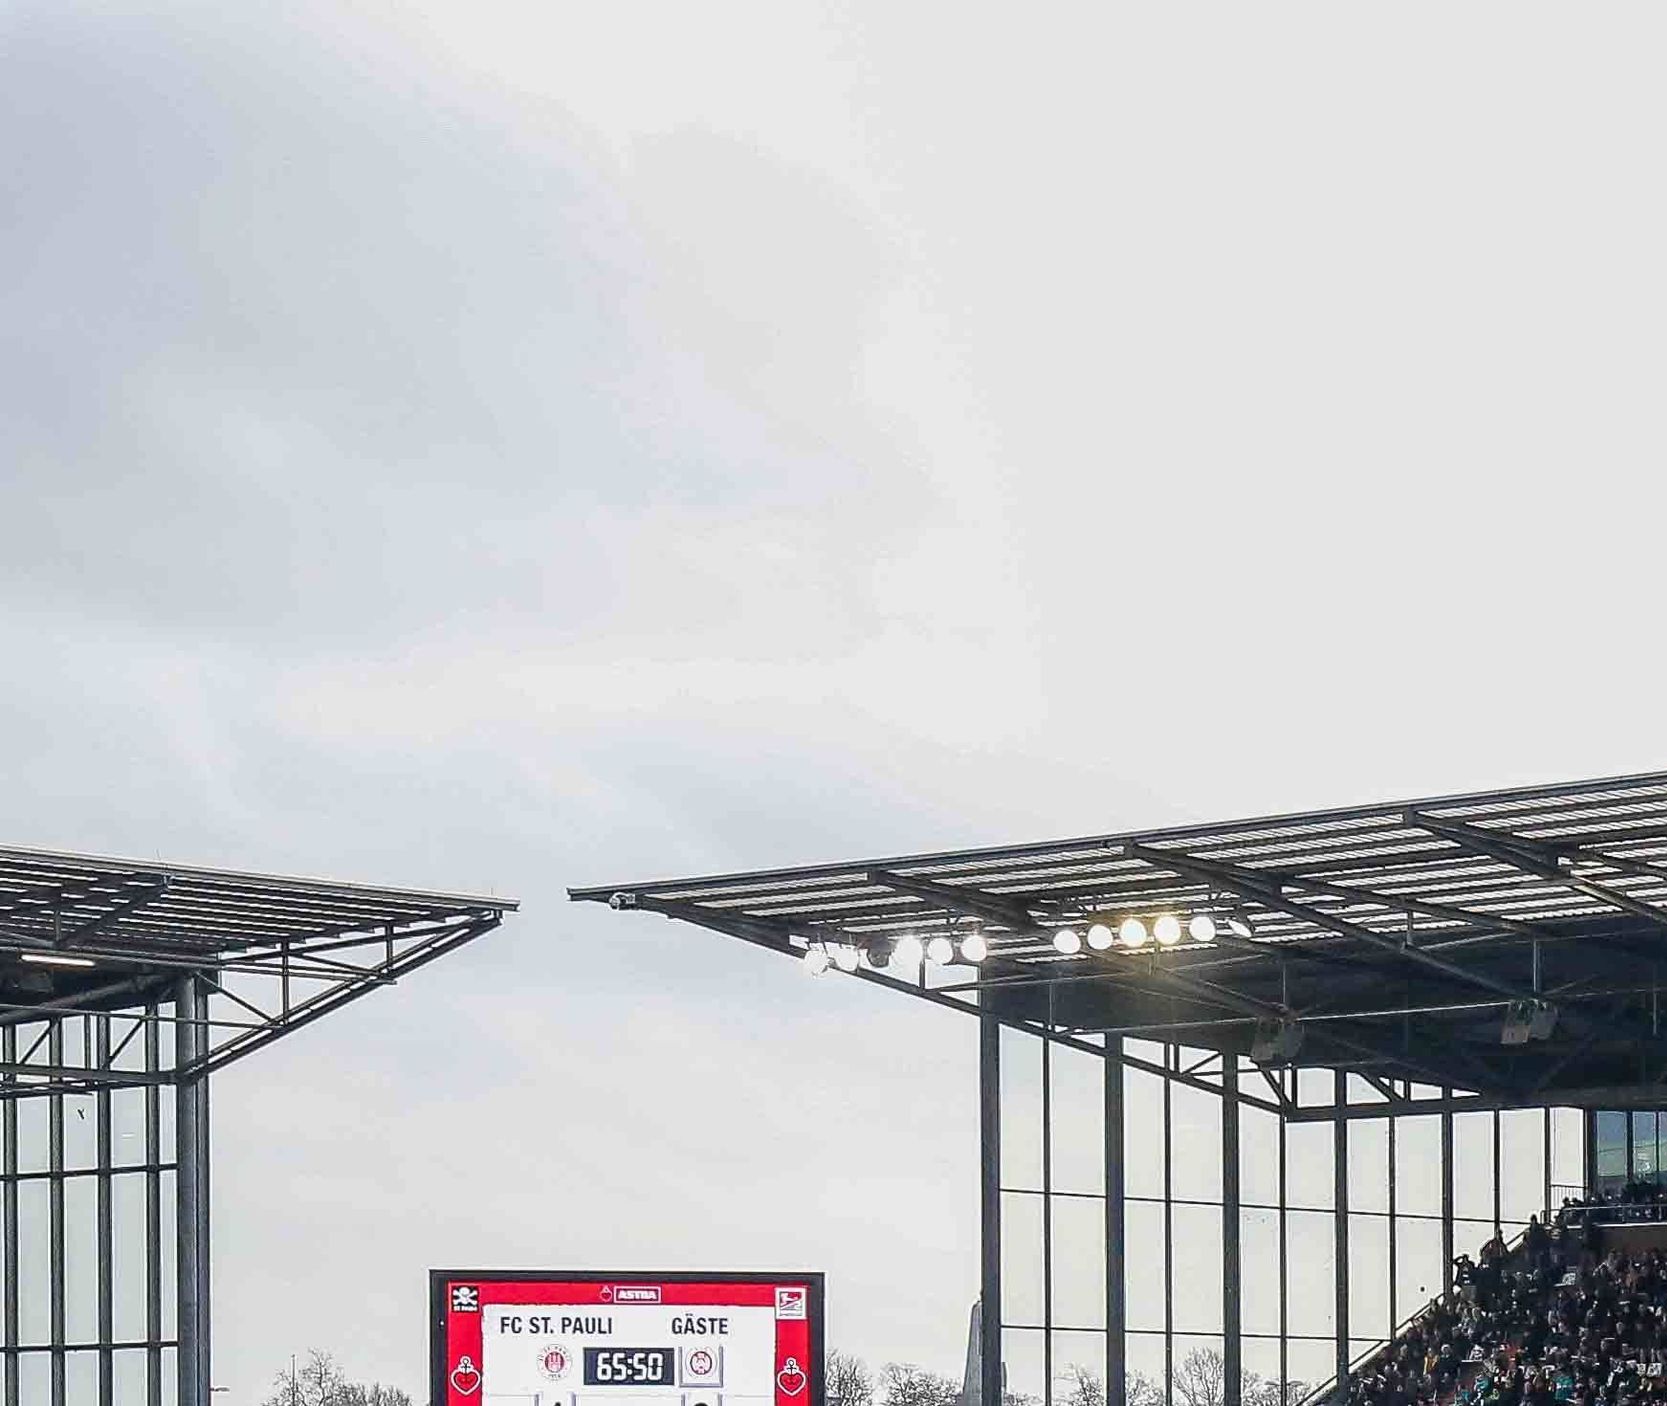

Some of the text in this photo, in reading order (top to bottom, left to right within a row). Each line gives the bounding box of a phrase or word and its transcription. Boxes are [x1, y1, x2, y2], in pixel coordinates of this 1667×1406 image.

[500, 1316, 613, 1335] FC ST. PAULI
[671, 1315, 729, 1335] GÄSTE
[596, 1352, 663, 1381] 65:50
